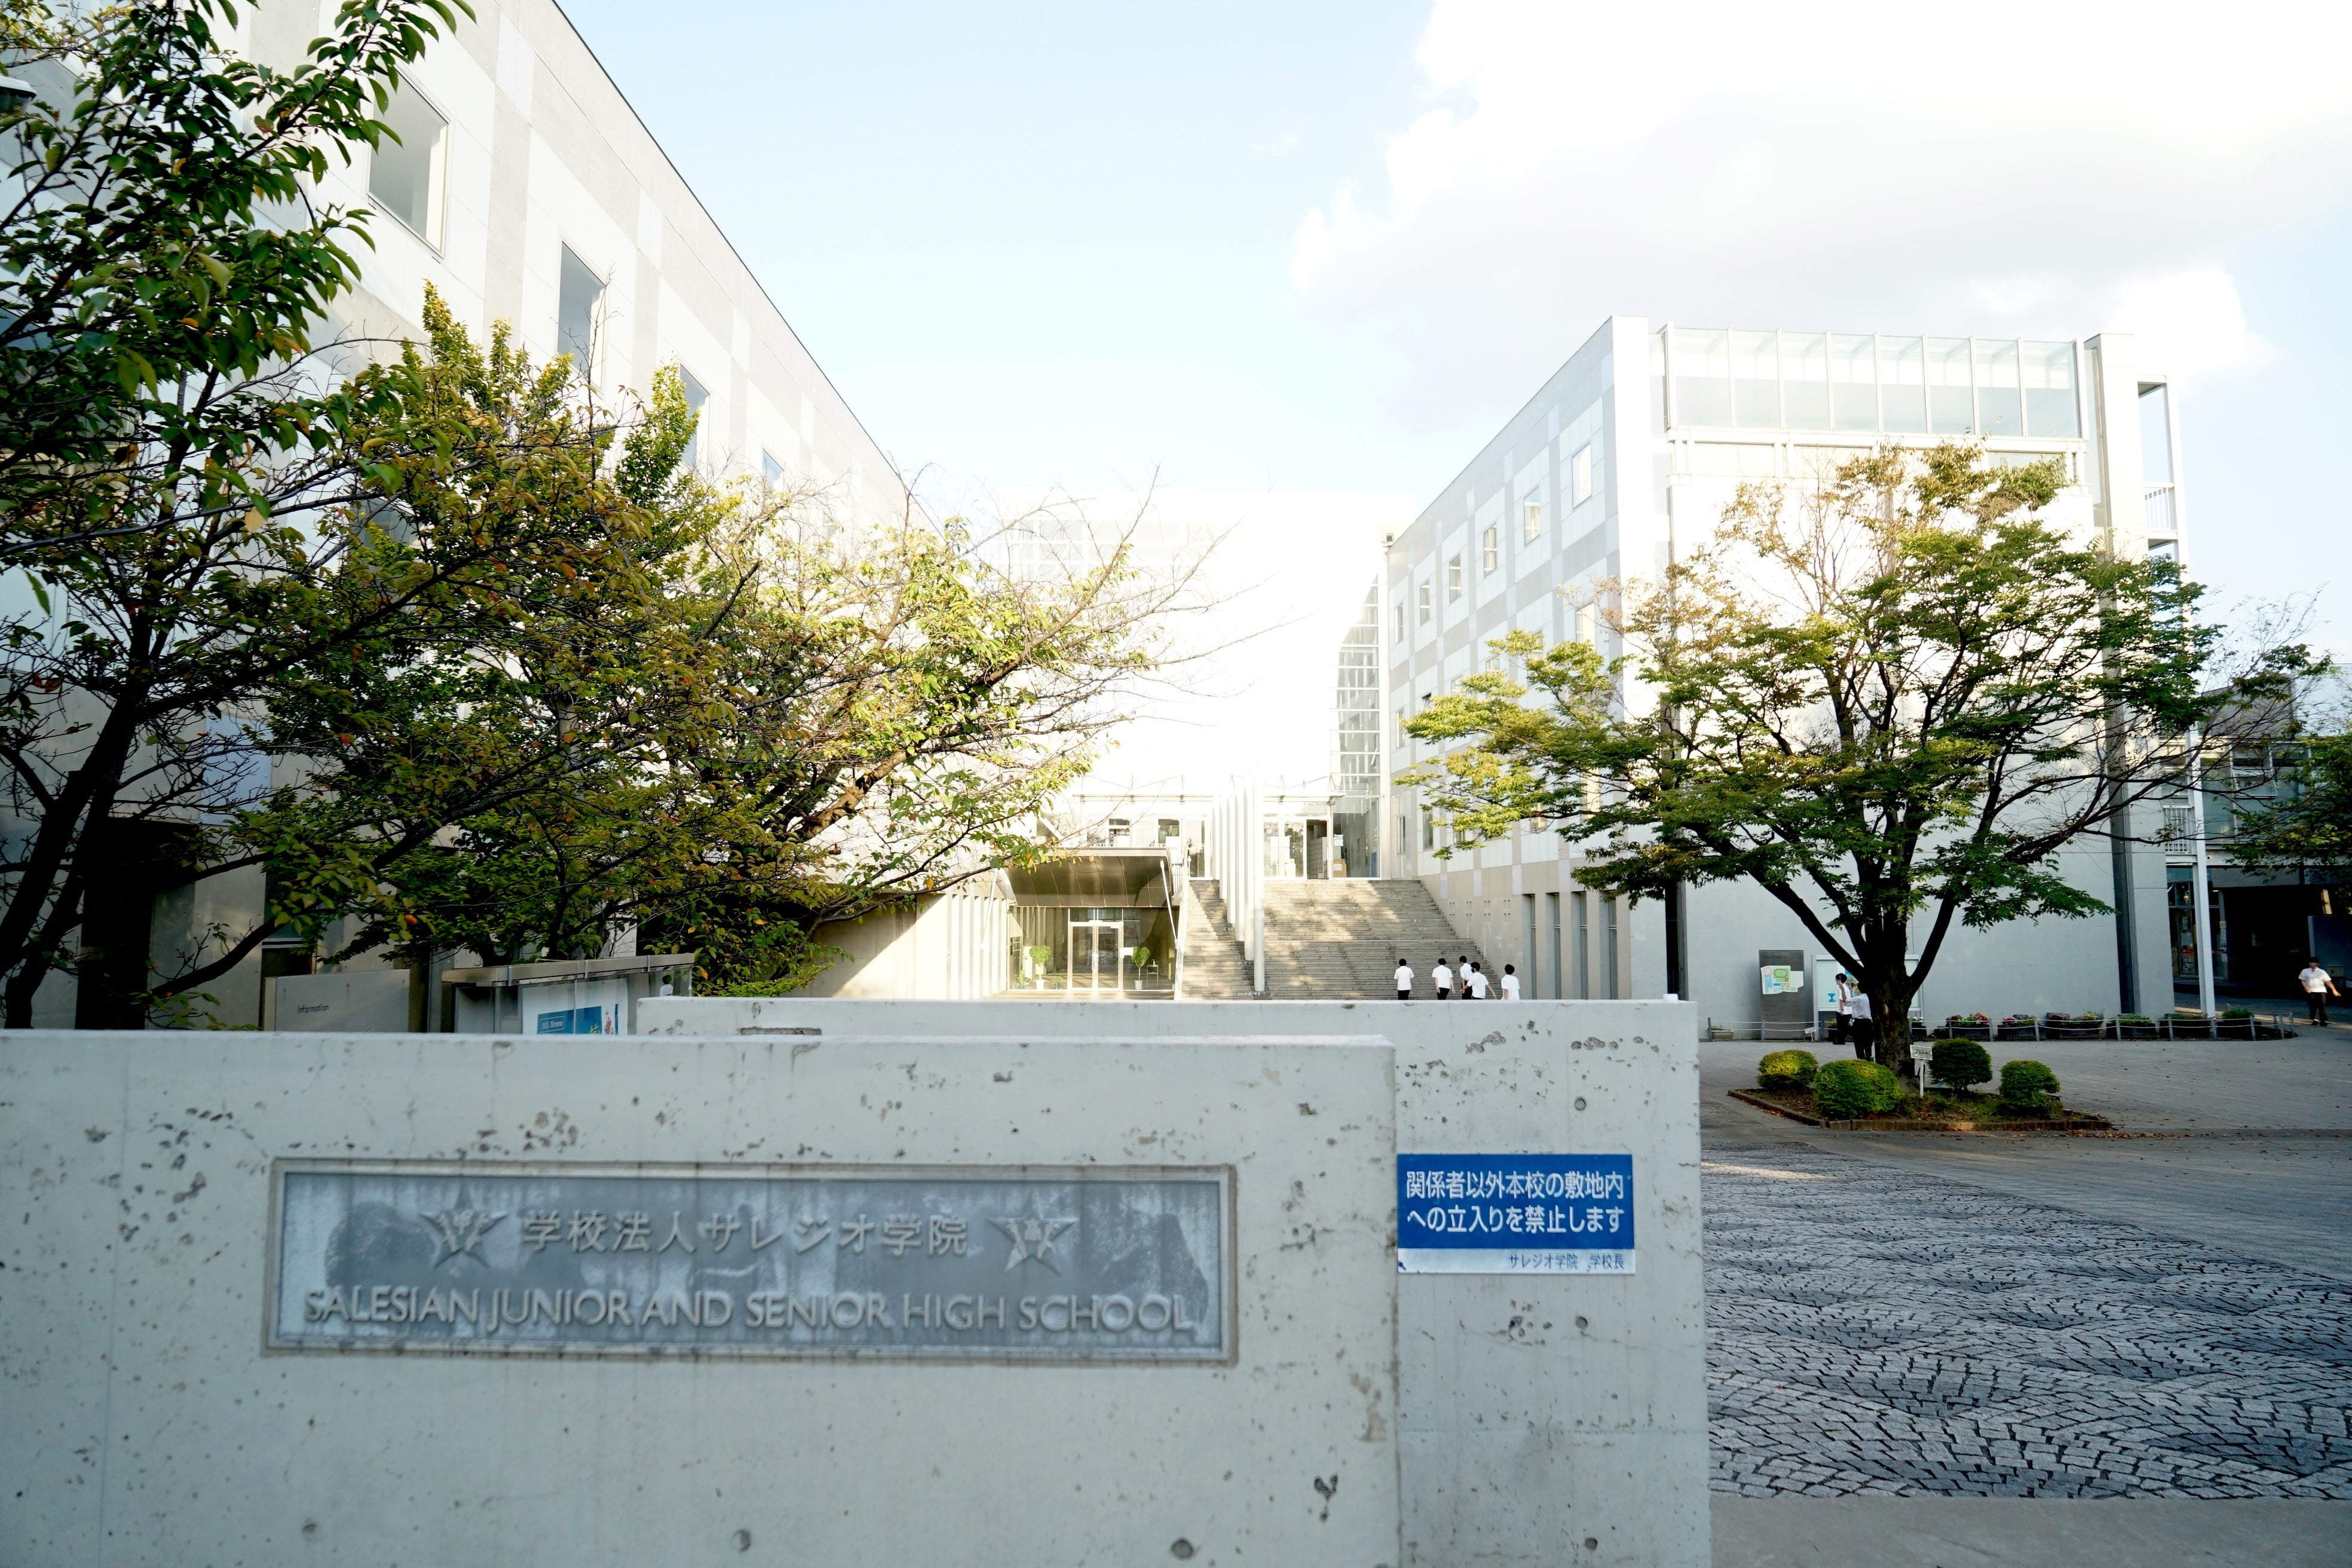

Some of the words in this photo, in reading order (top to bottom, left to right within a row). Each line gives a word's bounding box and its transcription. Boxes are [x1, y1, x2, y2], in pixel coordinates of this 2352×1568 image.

[1406, 1170, 1624, 1200] 関係者以外本校の敷地内
[522, 1208, 970, 1257] 学校法人サレジオ学院
[1407, 1204, 1625, 1234] への立入りを禁止します
[1508, 1252, 1578, 1270] サレジオ学院
[1590, 1252, 1625, 1270] 学校長
[304, 1285, 480, 1325] SALESIAN
[486, 1288, 632, 1332] JUNIOR
[641, 1290, 734, 1328] AND
[745, 1292, 892, 1330] SENIOR
[902, 1294, 1006, 1331] HIGH
[1018, 1294, 1193, 1332] SCHOOL
